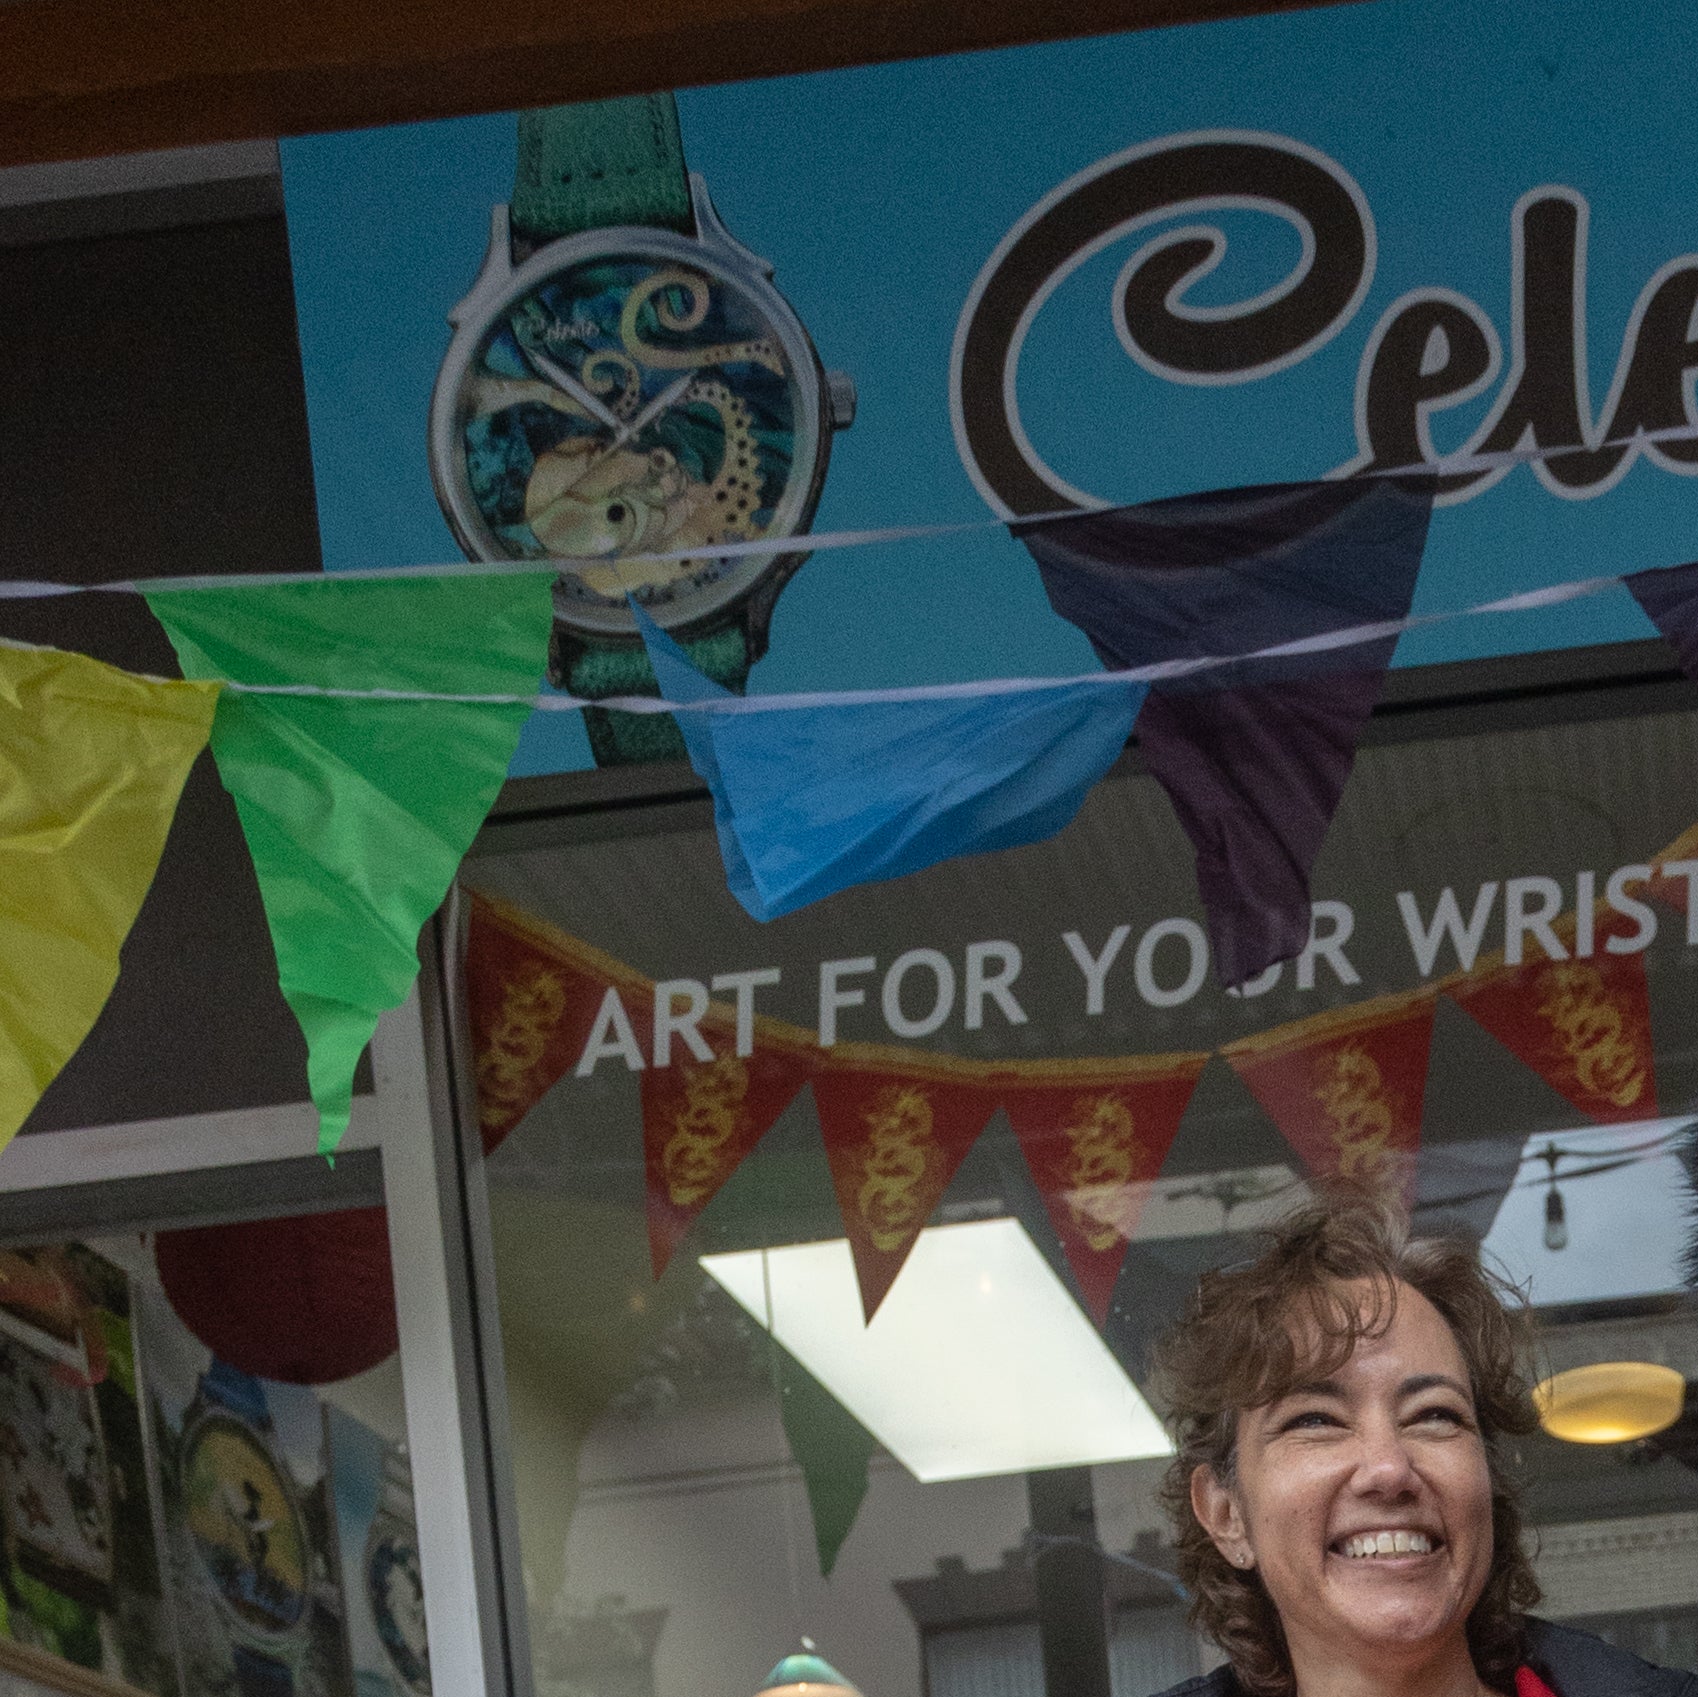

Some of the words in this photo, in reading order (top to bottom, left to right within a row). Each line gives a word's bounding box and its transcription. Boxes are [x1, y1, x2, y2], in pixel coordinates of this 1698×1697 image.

[574, 968, 781, 1077] ART
[816, 939, 1029, 1046] FOR
[1062, 900, 1362, 1016] YOR
